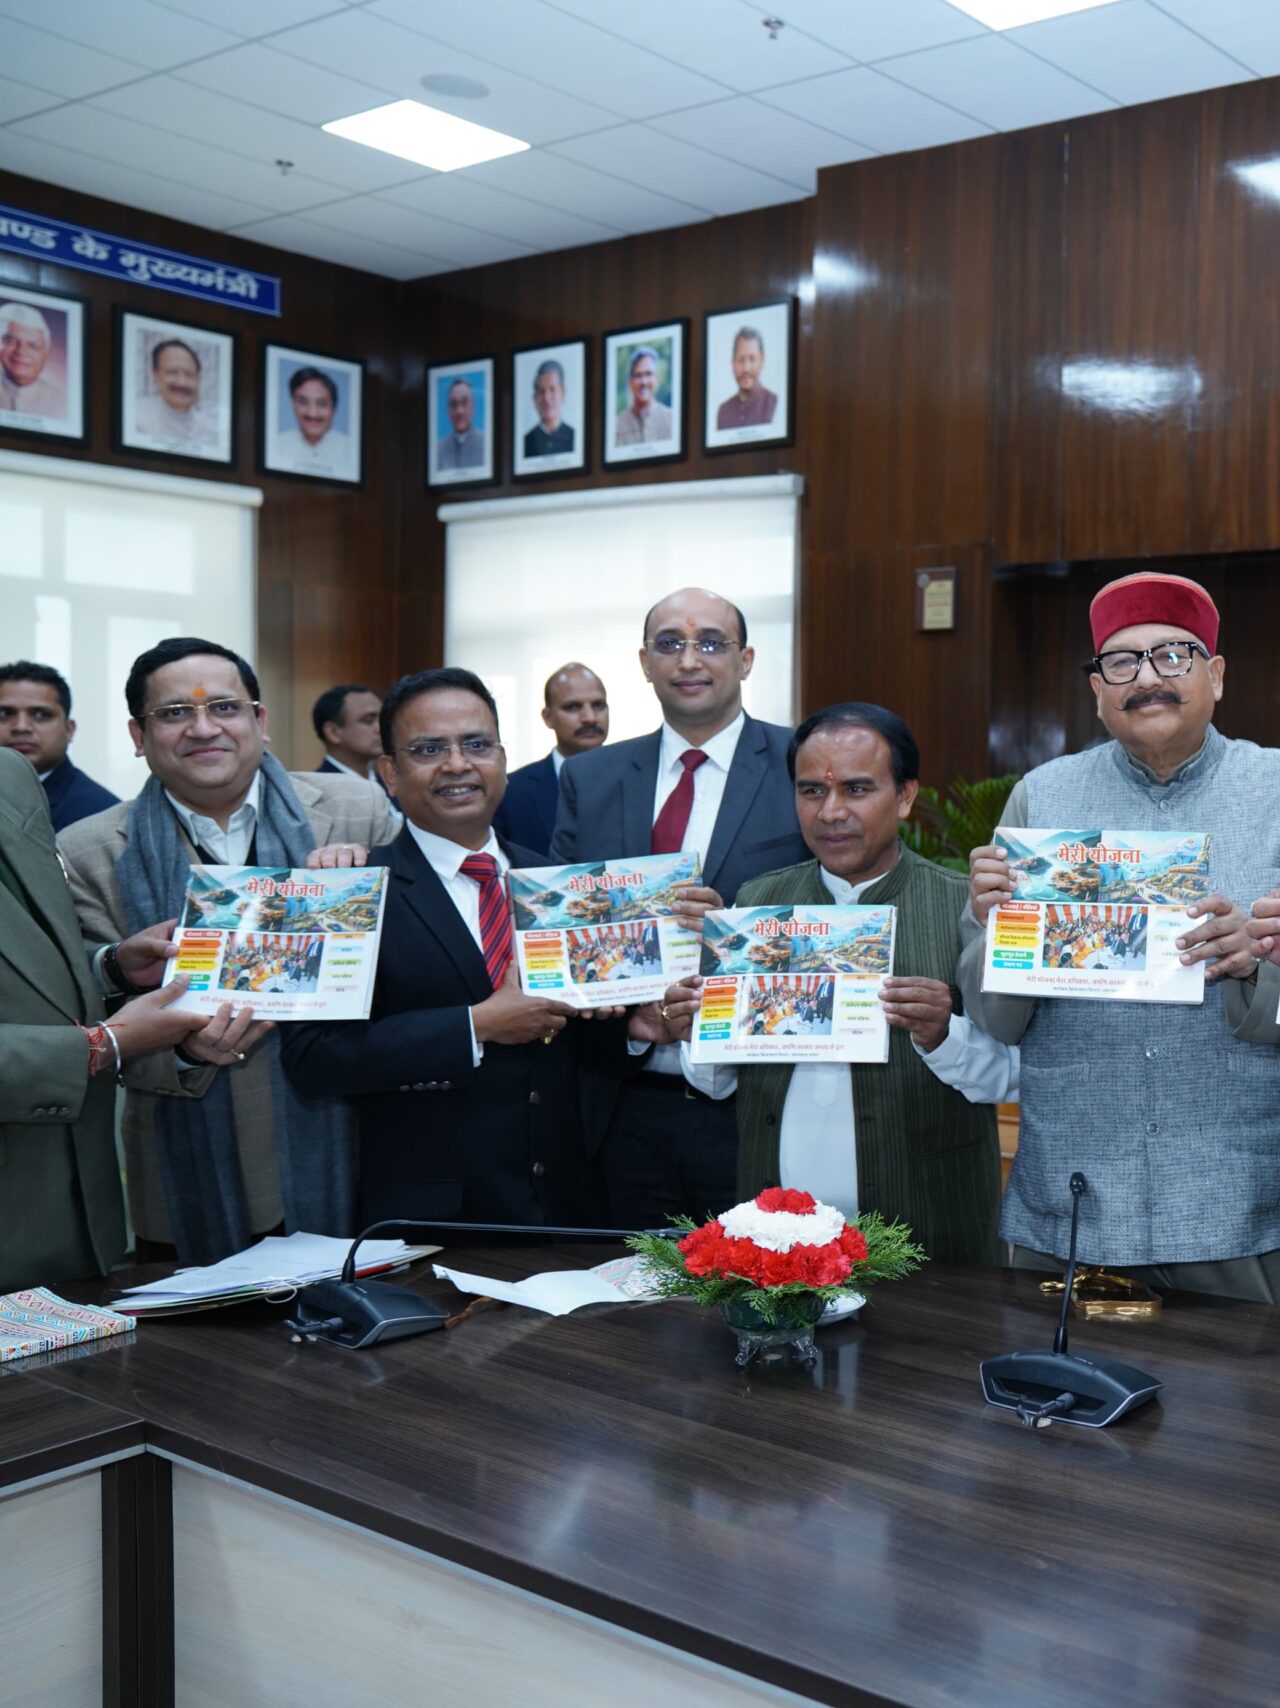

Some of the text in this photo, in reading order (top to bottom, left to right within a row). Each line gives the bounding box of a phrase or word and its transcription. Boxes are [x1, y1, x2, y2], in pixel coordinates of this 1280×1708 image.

[71, 233, 112, 261] के
[119, 248, 260, 300] मुख्यमंत्री
[1058, 844, 1141, 864] मेरी योजना
[247, 878, 325, 897] मेरी योजना
[569, 872, 644, 892] मेरी योजना
[754, 918, 831, 937] मेरी योजना
